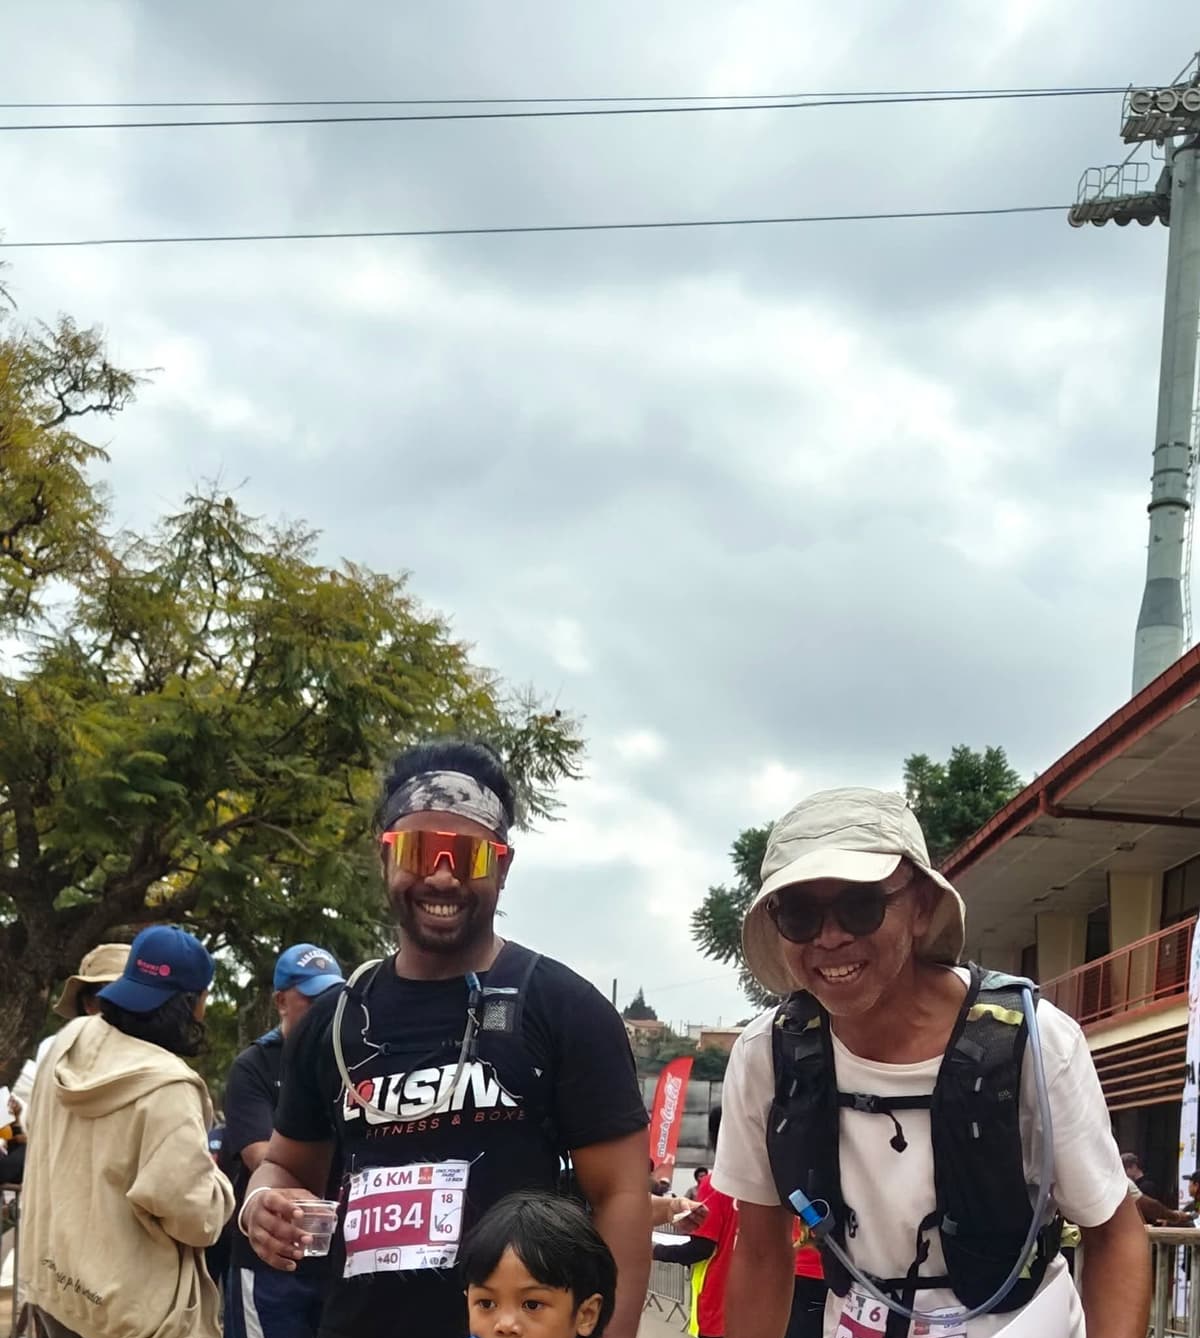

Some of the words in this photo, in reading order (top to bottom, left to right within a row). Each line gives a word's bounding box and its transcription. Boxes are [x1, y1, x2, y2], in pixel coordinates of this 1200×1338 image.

[366, 1117, 440, 1140] FITNESS
[451, 1113, 461, 1126] &
[373, 1172, 382, 1188] 6
[386, 1170, 412, 1187] KM
[441, 1194, 453, 1204] 18
[363, 1202, 424, 1235] 1134
[377, 1252, 399, 1264] +40
[869, 1306, 881, 1322] 6
